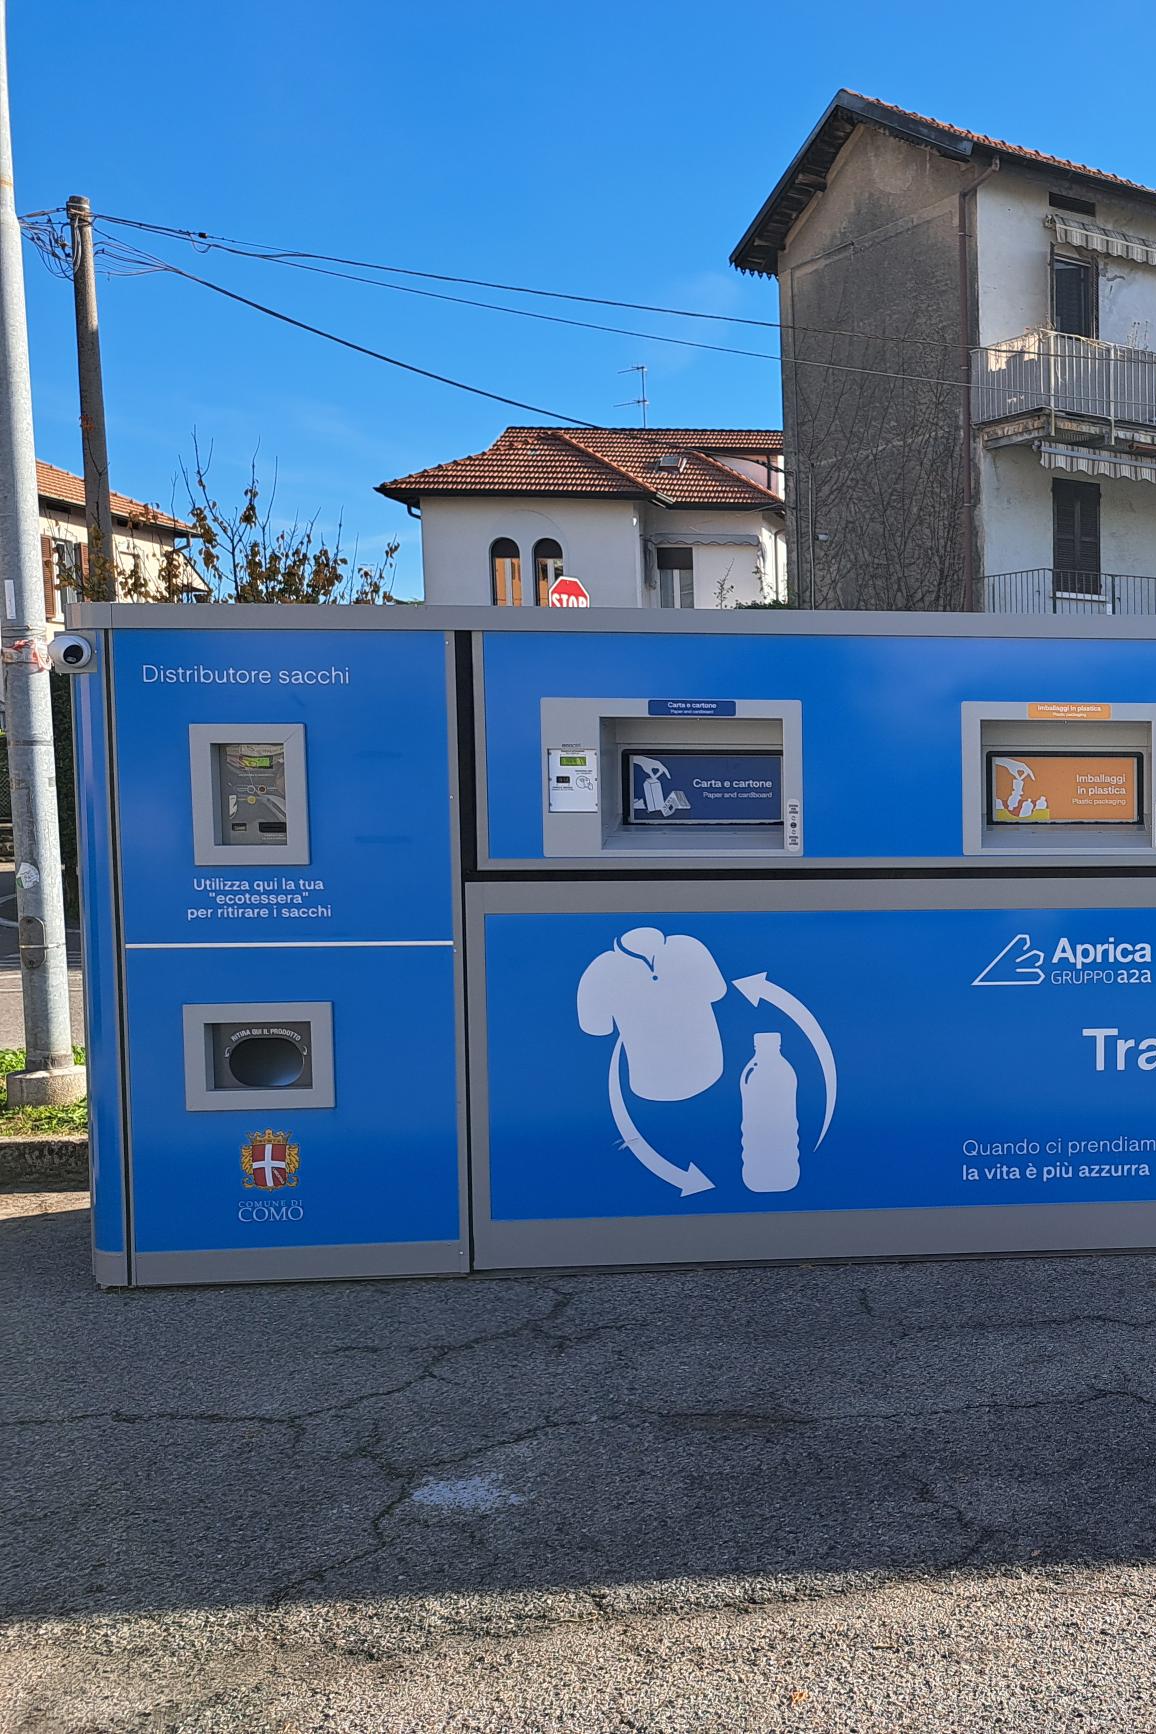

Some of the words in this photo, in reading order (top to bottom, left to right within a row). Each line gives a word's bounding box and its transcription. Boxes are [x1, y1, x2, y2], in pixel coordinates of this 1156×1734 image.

[143, 664, 272, 684] Distributore
[279, 666, 349, 684] sacchi
[1037, 704, 1070, 713] Imballaggi
[693, 779, 722, 788] Carta
[732, 780, 773, 788] cartone
[1076, 773, 1126, 785] Imballaggi
[703, 791, 723, 799] Paper
[1077, 786, 1086, 795] in
[1088, 786, 1126, 797] plastica
[193, 878, 250, 891] Utilizza
[253, 878, 278, 893] qui
[282, 878, 295, 890] la
[298, 879, 325, 890] tua
[208, 892, 309, 905] "ecotessera"
[187, 908, 214, 921] per
[217, 906, 269, 918] ritirare
[273, 906, 277, 918] i
[281, 905, 332, 918] sacchi
[1051, 937, 1152, 969] Aprica
[1050, 970, 1114, 985] GRUPPO
[1116, 969, 1152, 984] a2a
[962, 1138, 1040, 1157] Quando
[1045, 1137, 1062, 1154] ci
[962, 1164, 980, 1181] la
[984, 1163, 1021, 1180] vita
[1025, 1162, 1037, 1179] è
[1042, 1161, 1073, 1182] più
[1078, 1163, 1151, 1178] azzurra
[238, 1200, 287, 1208] COMUNE
[238, 1205, 304, 1222] COMO
